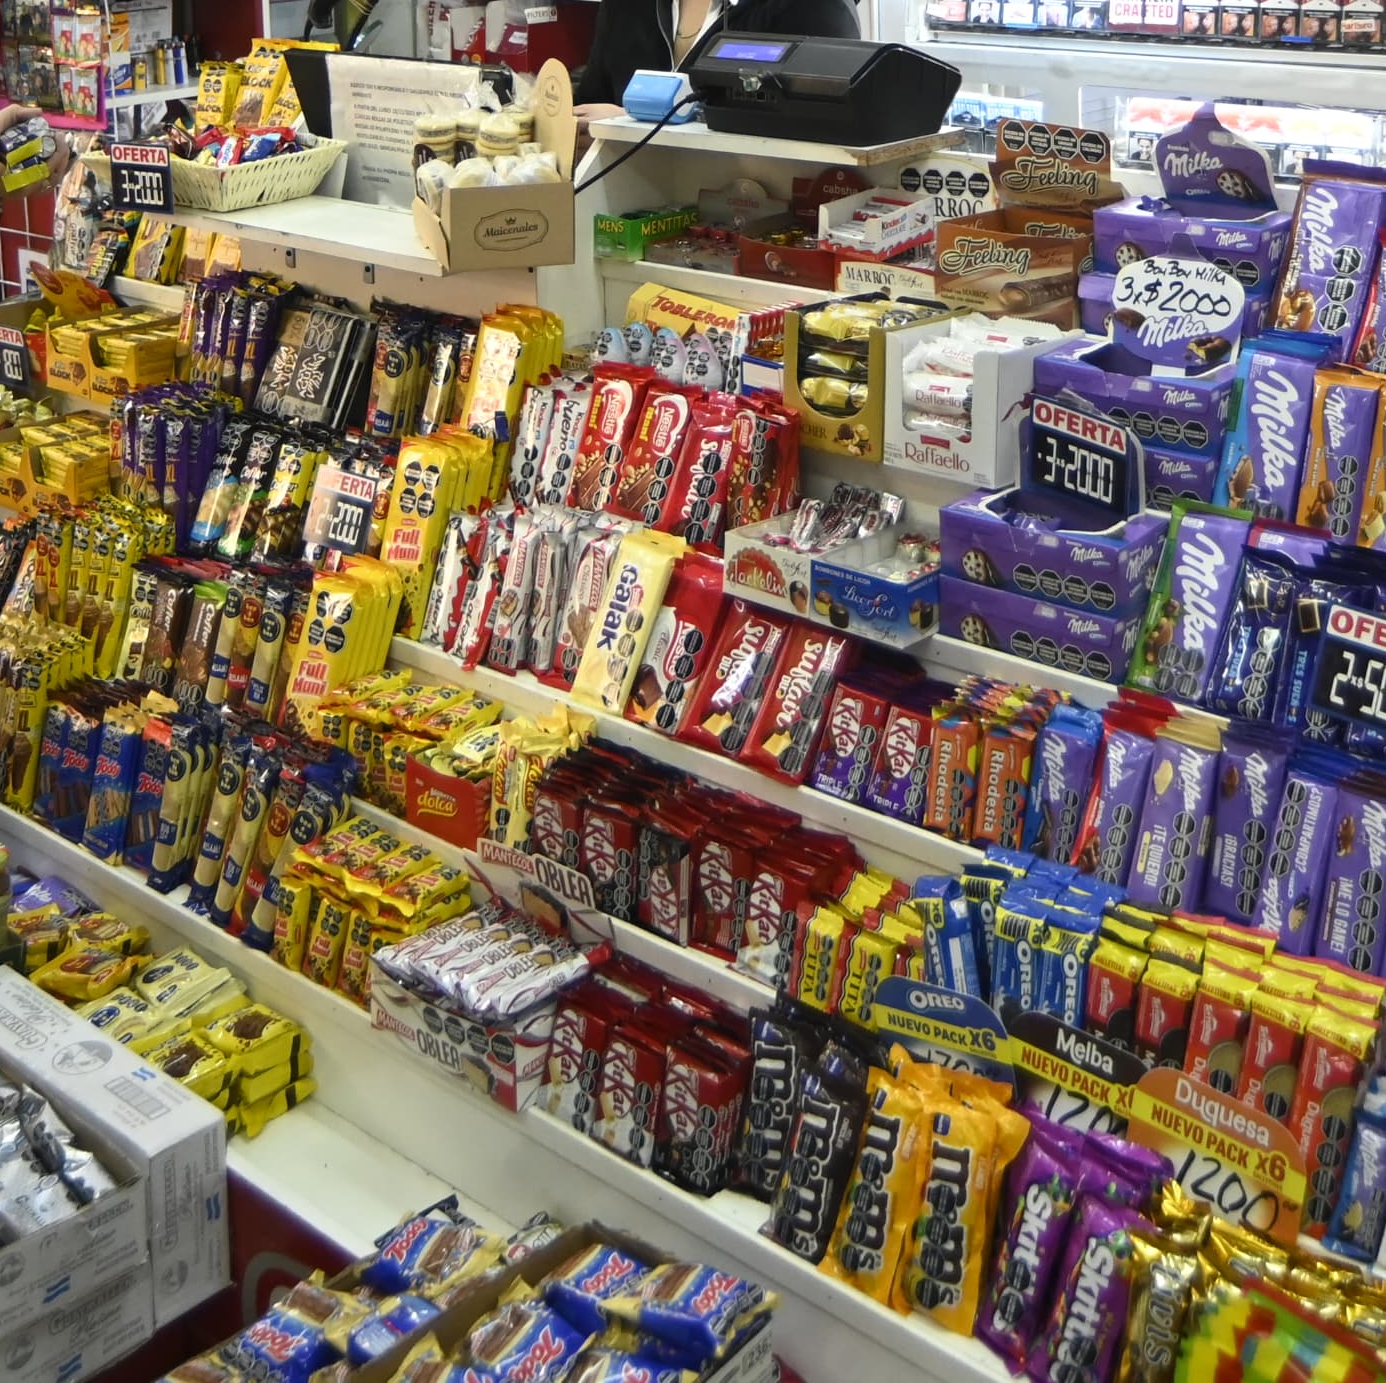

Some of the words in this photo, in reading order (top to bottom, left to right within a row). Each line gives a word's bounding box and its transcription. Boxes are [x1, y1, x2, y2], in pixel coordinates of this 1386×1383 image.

[241, 75, 273, 89] BLOCK
[113, 146, 166, 164] OFERTA
[1164, 151, 1224, 179] Milka
[1001, 156, 1099, 196] Feeling
[483, 223, 538, 238] Maicenales
[597, 219, 624, 233] MENS
[641, 213, 699, 237] MENTITAS
[1215, 231, 1249, 247] Milka
[939, 236, 1031, 276] Feeling
[845, 266, 895, 287] MARROC
[652, 295, 740, 333] TOBLERON
[1136, 315, 1209, 349] Milka
[915, 389, 962, 409] Raffaello
[1035, 400, 1125, 452] OFERTA
[1245, 370, 1299, 490] Milka
[904, 441, 970, 472] Raffaello
[596, 563, 640, 650] Galak
[63, 747, 90, 770] Toddy
[95, 754, 121, 779] Toddy
[817, 771, 842, 790] TRIPLE
[934, 738, 952, 824] Rhodesia
[984, 748, 1006, 846] Rhodesia
[417, 789, 457, 816] dolca
[1293, 787, 1322, 876] ¿COMPARTIMOS?
[482, 845, 534, 875] MANTECOL
[536, 857, 592, 903] OBLEA
[700, 840, 733, 914] KitKat
[750, 872, 783, 945] KitKat
[801, 946, 820, 996] TITA
[909, 990, 965, 1011] OREO
[375, 1013, 415, 1040] MANTECOL
[553, 1008, 588, 1084] KitKat
[887, 1012, 931, 1039] NUEVO
[932, 1025, 968, 1047] PACK
[969, 1028, 996, 1052] X6
[416, 1027, 461, 1070] OBLEA
[1056, 1027, 1114, 1074] Melba
[1021, 1046, 1069, 1082] NUEVO
[1071, 1070, 1111, 1104] PACK
[1175, 1079, 1270, 1147] Duquesa
[1151, 1102, 1205, 1144] NUEVO
[1206, 1131, 1249, 1170] PACK
[1256, 1150, 1286, 1182] X6
[584, 1250, 635, 1300] Toddy
